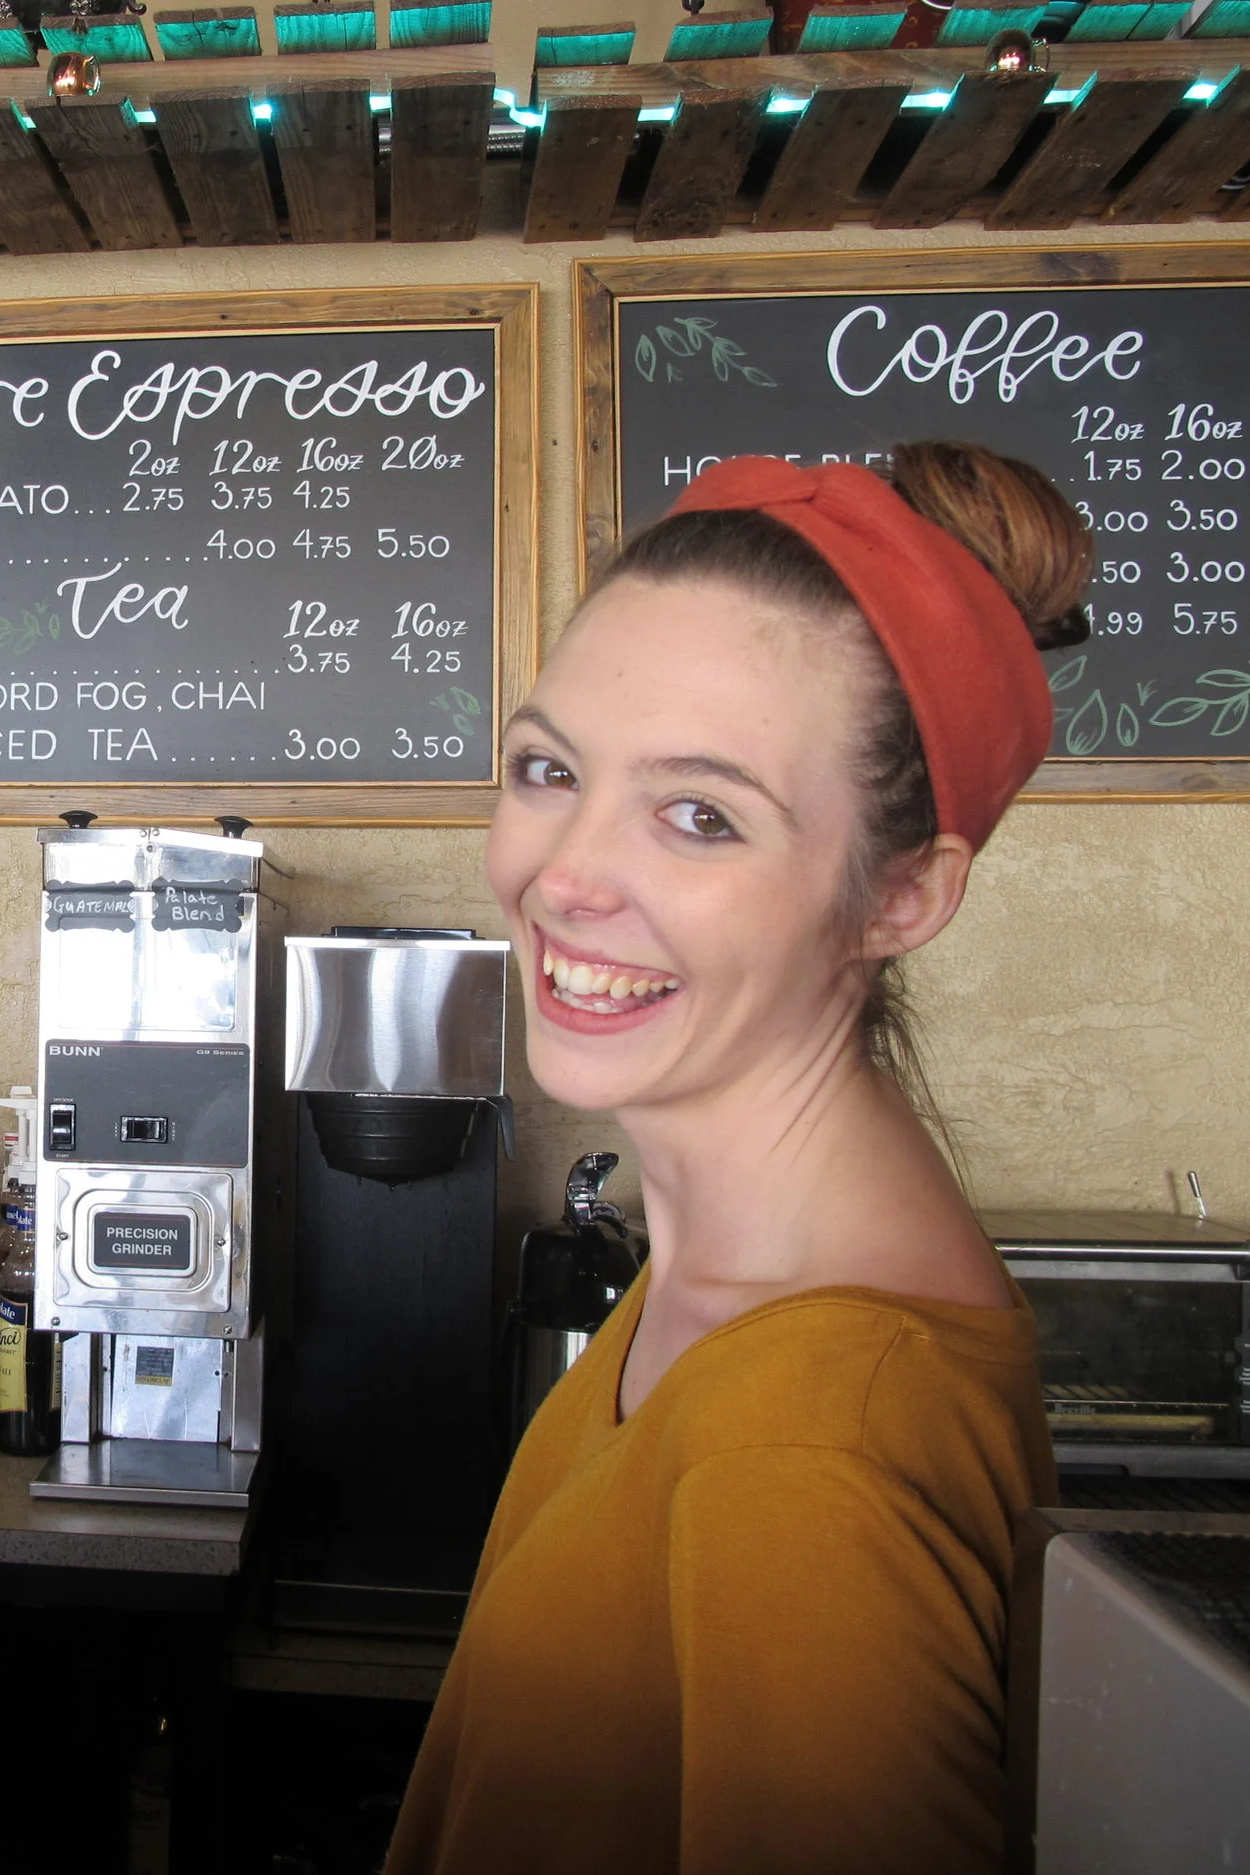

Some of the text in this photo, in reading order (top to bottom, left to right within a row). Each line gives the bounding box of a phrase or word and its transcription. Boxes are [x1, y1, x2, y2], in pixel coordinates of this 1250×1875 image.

[827, 305, 1144, 404] Coffee
[67, 350, 485, 446] Espresso
[1071, 403, 1243, 443] 12oz 16oz
[129, 439, 182, 477] 2oz
[209, 439, 282, 477] 12oz
[296, 437, 364, 473] 16oz
[1084, 450, 1246, 481] 1.75 2.00
[122, 481, 184, 512] 2.75
[211, 481, 273, 510] 3.75
[292, 480, 350, 509] 4.25
[1075, 499, 1238, 532] 3.00 3.50
[206, 528, 276, 560] 4.00
[292, 528, 351, 560] 4.75
[377, 528, 450, 558] 5.50
[1083, 551, 1246, 584] .50 3.00
[56, 562, 189, 640] Tea
[282, 600, 469, 639] 12oz 16oz
[1174, 603, 1238, 635] 5.75
[287, 643, 351, 674] 3.75
[391, 642, 462, 674] 4.25
[171, 681, 265, 711] CHAI
[88, 728, 158, 761] TEA
[285, 729, 360, 760] 3.00
[391, 728, 464, 759] 3.50
[166, 886, 218, 906] Palate
[171, 904, 224, 922] Blend
[49, 1045, 101, 1058] BUNN
[106, 1227, 179, 1241] PRECISION
[111, 1243, 173, 1257] GRINDER
